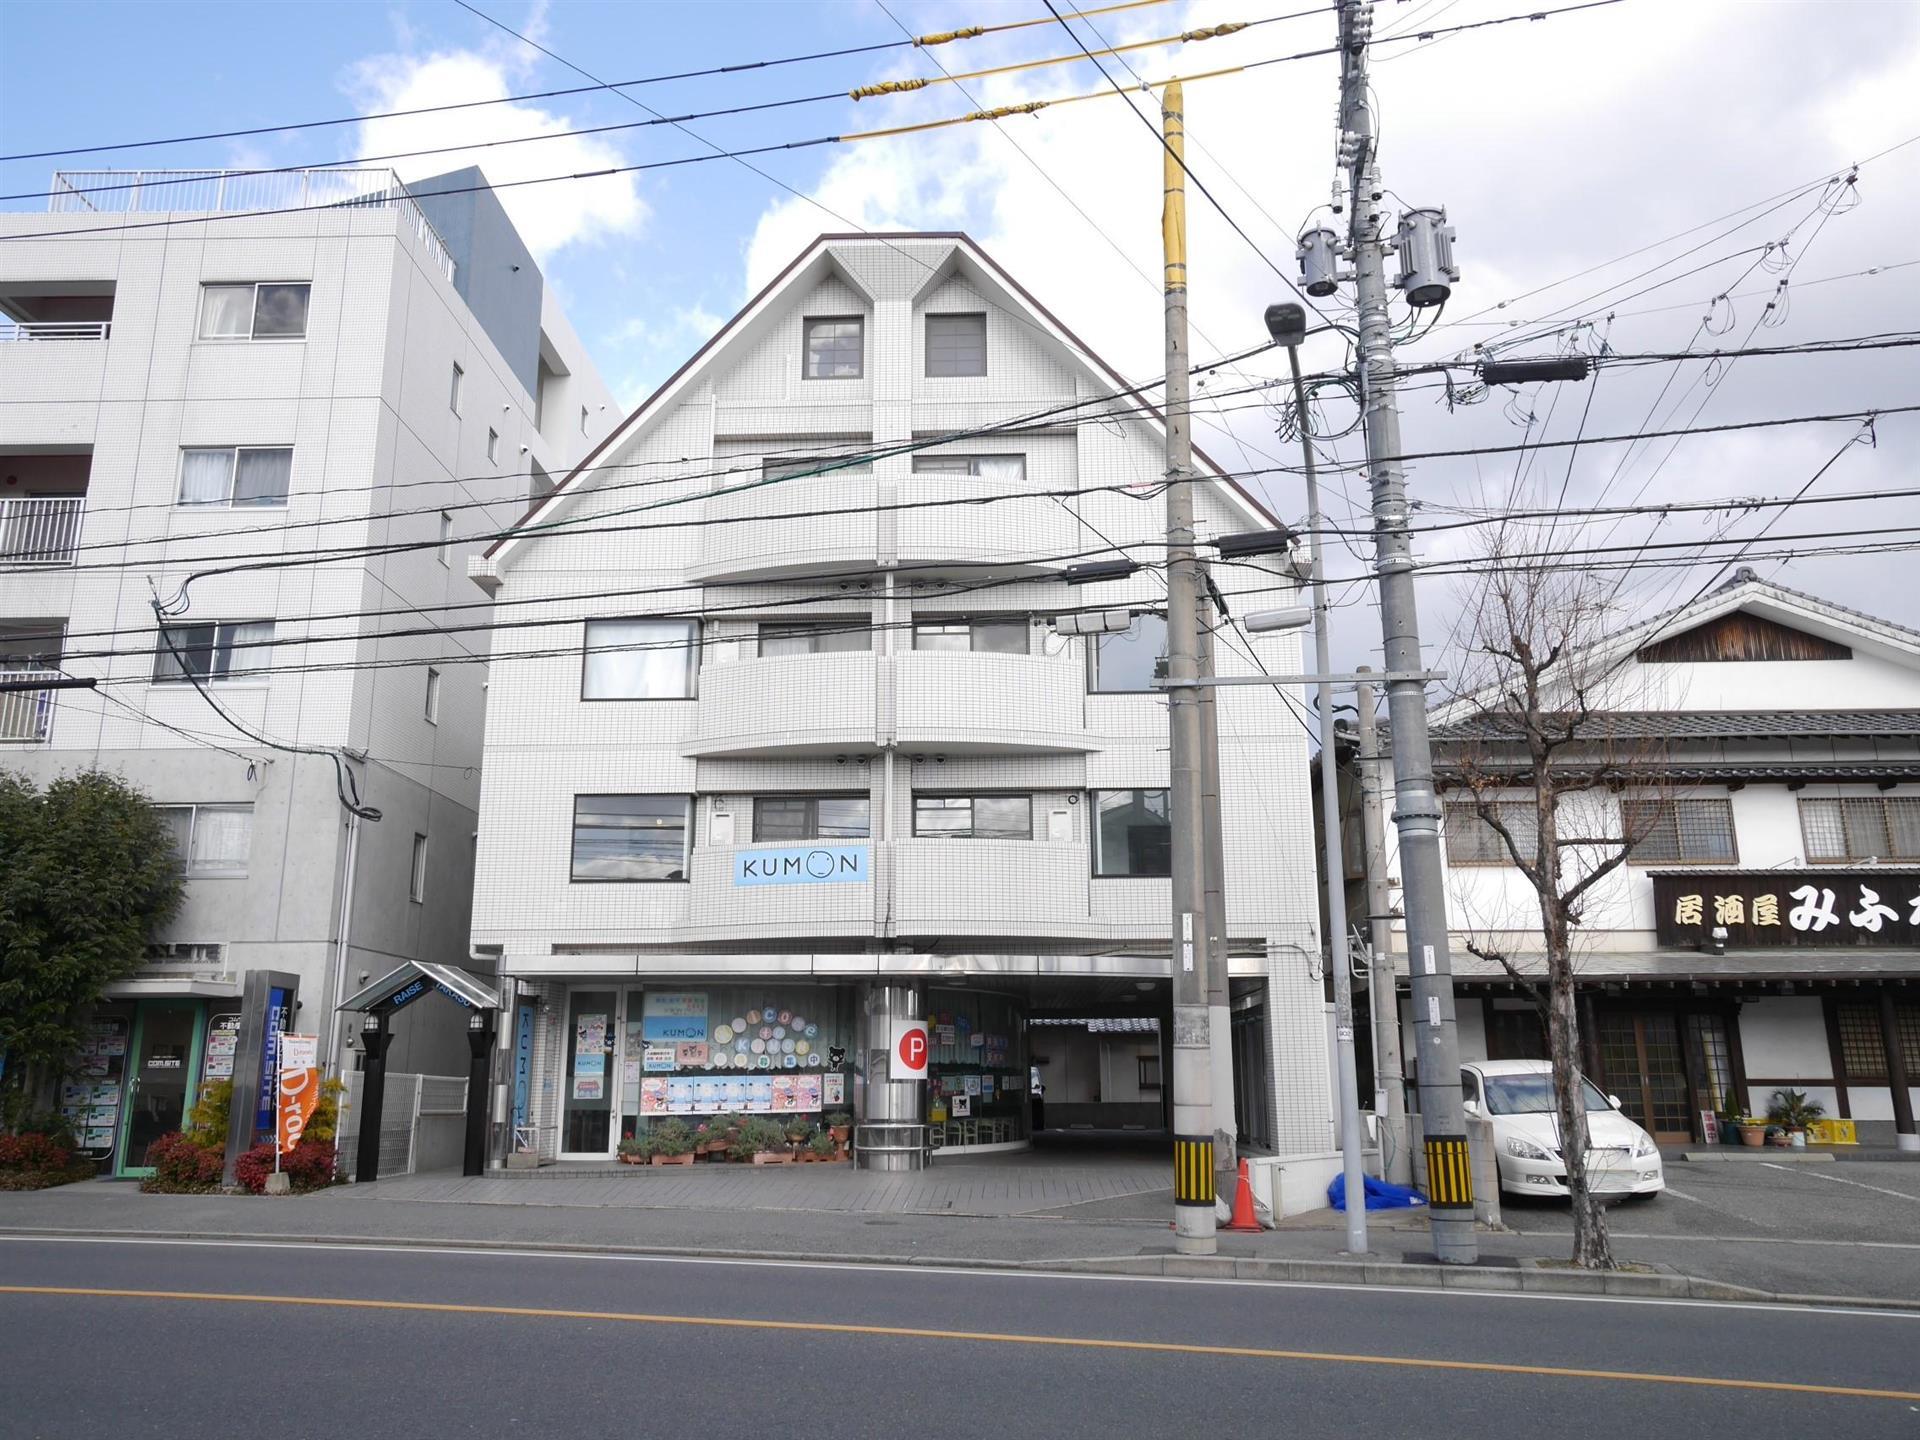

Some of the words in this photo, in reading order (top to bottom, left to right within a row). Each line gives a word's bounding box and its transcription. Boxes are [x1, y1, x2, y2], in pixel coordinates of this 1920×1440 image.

[743, 850, 858, 879] KUMON
[1675, 894, 1782, 926] 居酒屋
[1789, 884, 1920, 933] みふ
[393, 981, 423, 1005] RAISE
[663, 1027, 704, 1039] KUMON
[911, 1037, 924, 1062] P
